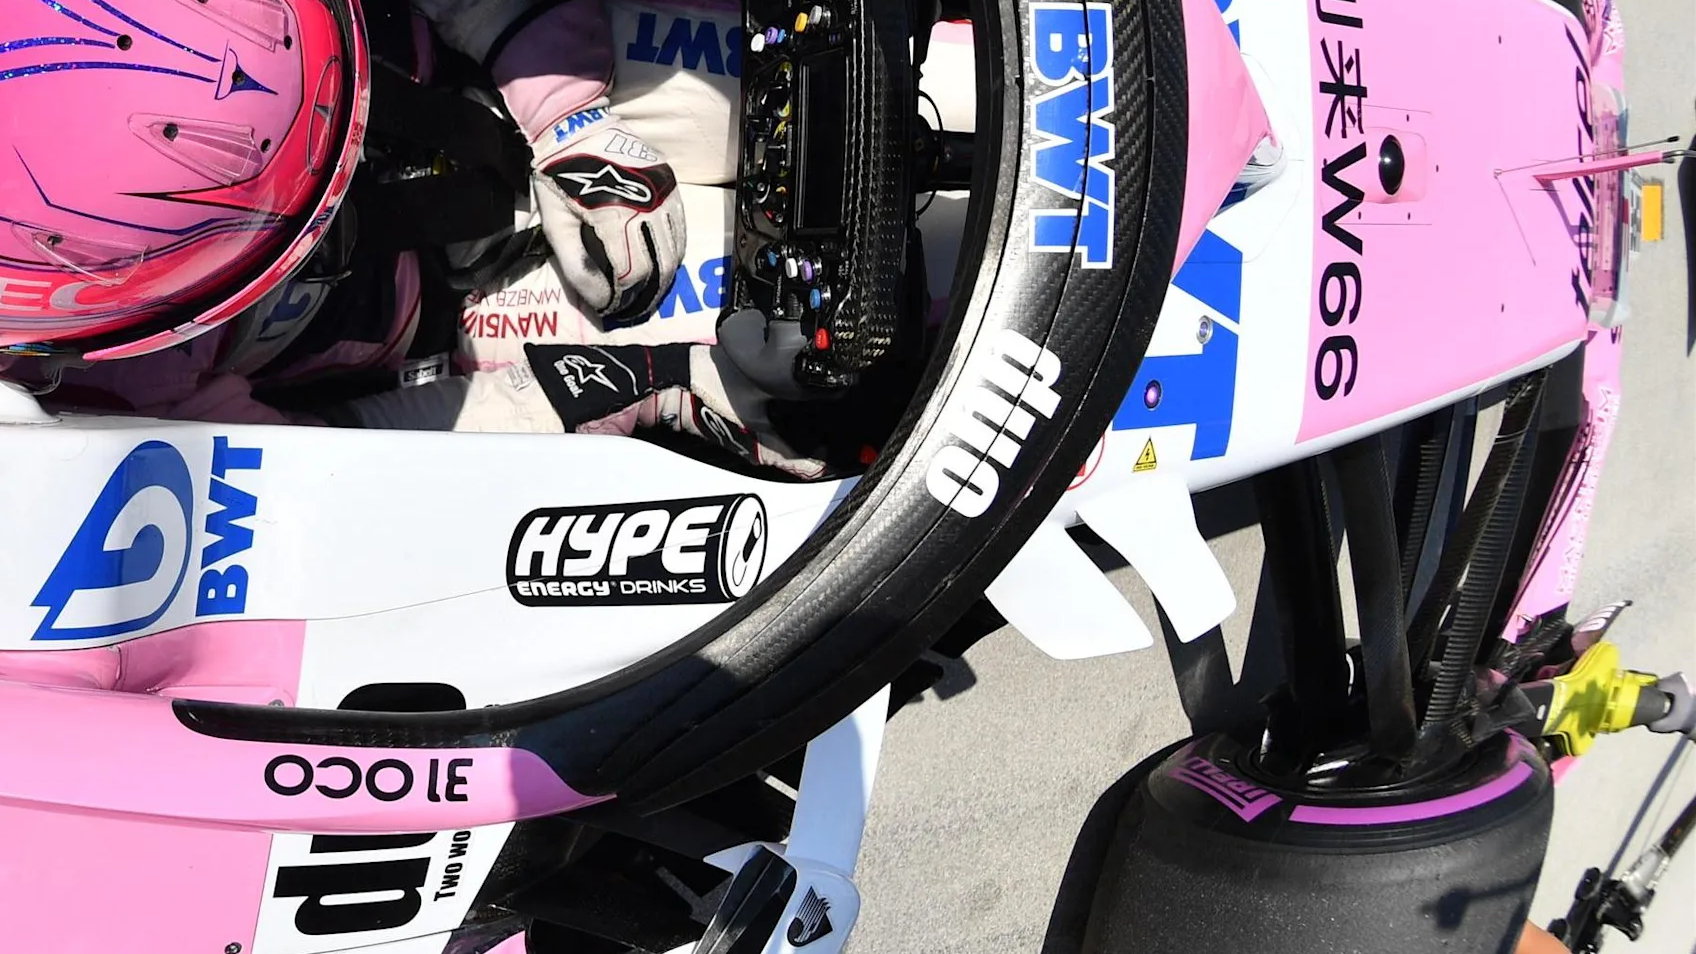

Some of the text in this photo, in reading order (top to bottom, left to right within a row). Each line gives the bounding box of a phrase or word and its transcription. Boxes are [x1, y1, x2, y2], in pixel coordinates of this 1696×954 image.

[1028, 1, 1116, 271] BWT
[924, 327, 1063, 519] duo
[195, 435, 264, 618] BWT
[514, 504, 725, 577] HYPE
[516, 578, 707, 597] ENERGY DRINKS
[263, 754, 474, 803] 31 OCO
